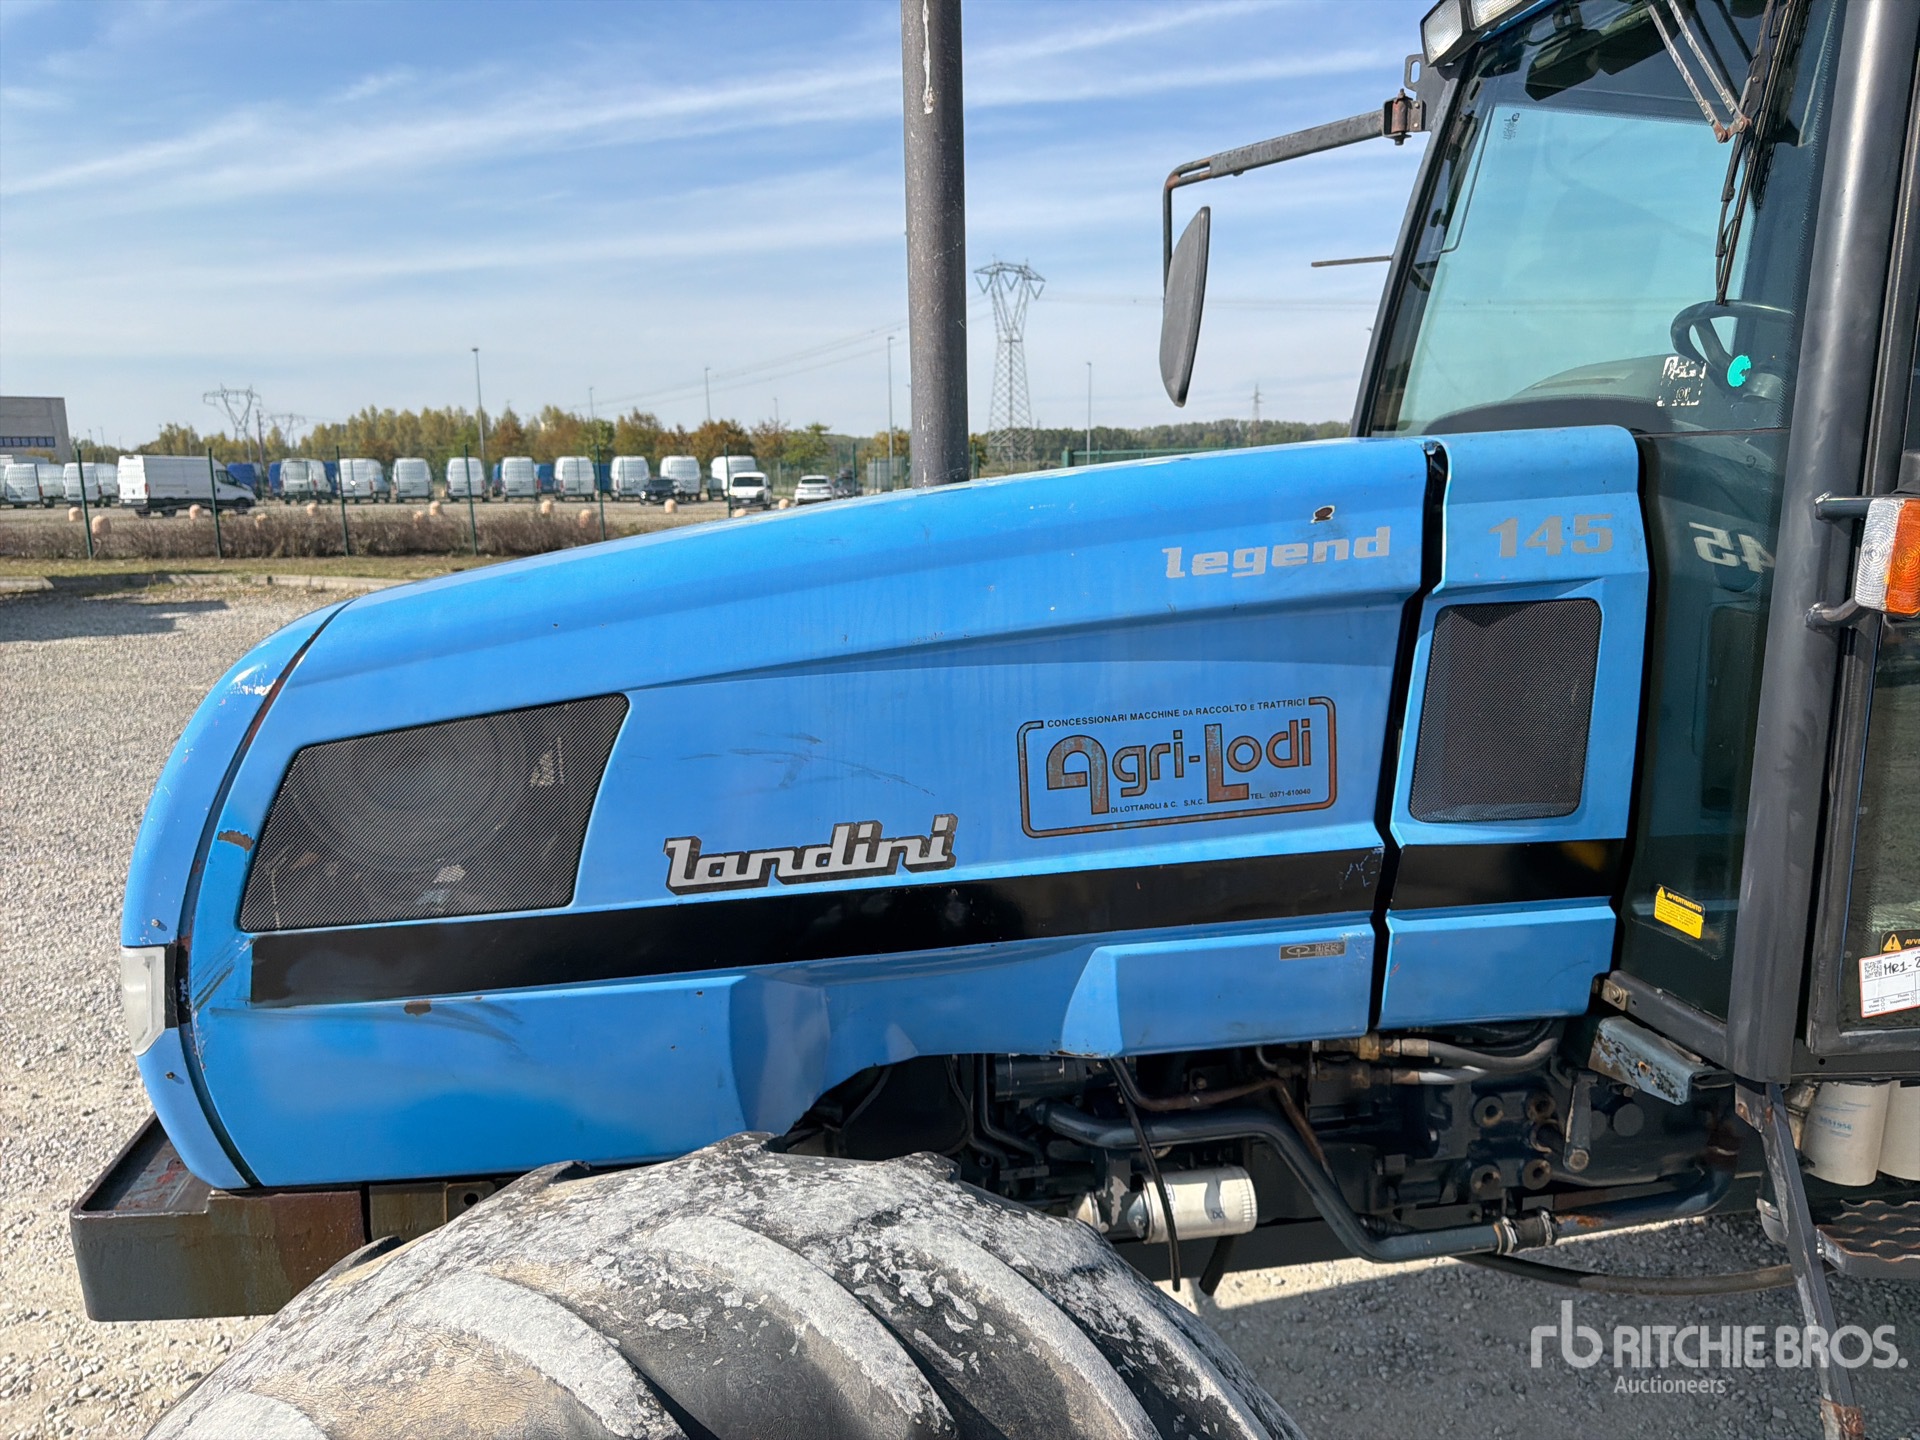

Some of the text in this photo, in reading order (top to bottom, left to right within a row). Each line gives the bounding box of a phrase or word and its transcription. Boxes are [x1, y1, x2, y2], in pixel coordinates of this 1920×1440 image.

[1161, 524, 1391, 579] legend
[1488, 513, 1614, 558] 145
[1047, 714, 1128, 728] CONCESSIONARI
[1130, 709, 1180, 721] MACCHINE
[1182, 709, 1194, 717] DA
[1195, 703, 1248, 716] RACCOLTO
[1258, 698, 1306, 710] TRATTRICI
[1046, 718, 1312, 815] Agri-Lodi
[1110, 806, 1119, 814] DI
[1120, 802, 1162, 813] LOTTAROLI
[1183, 798, 1206, 807] S.N.C.
